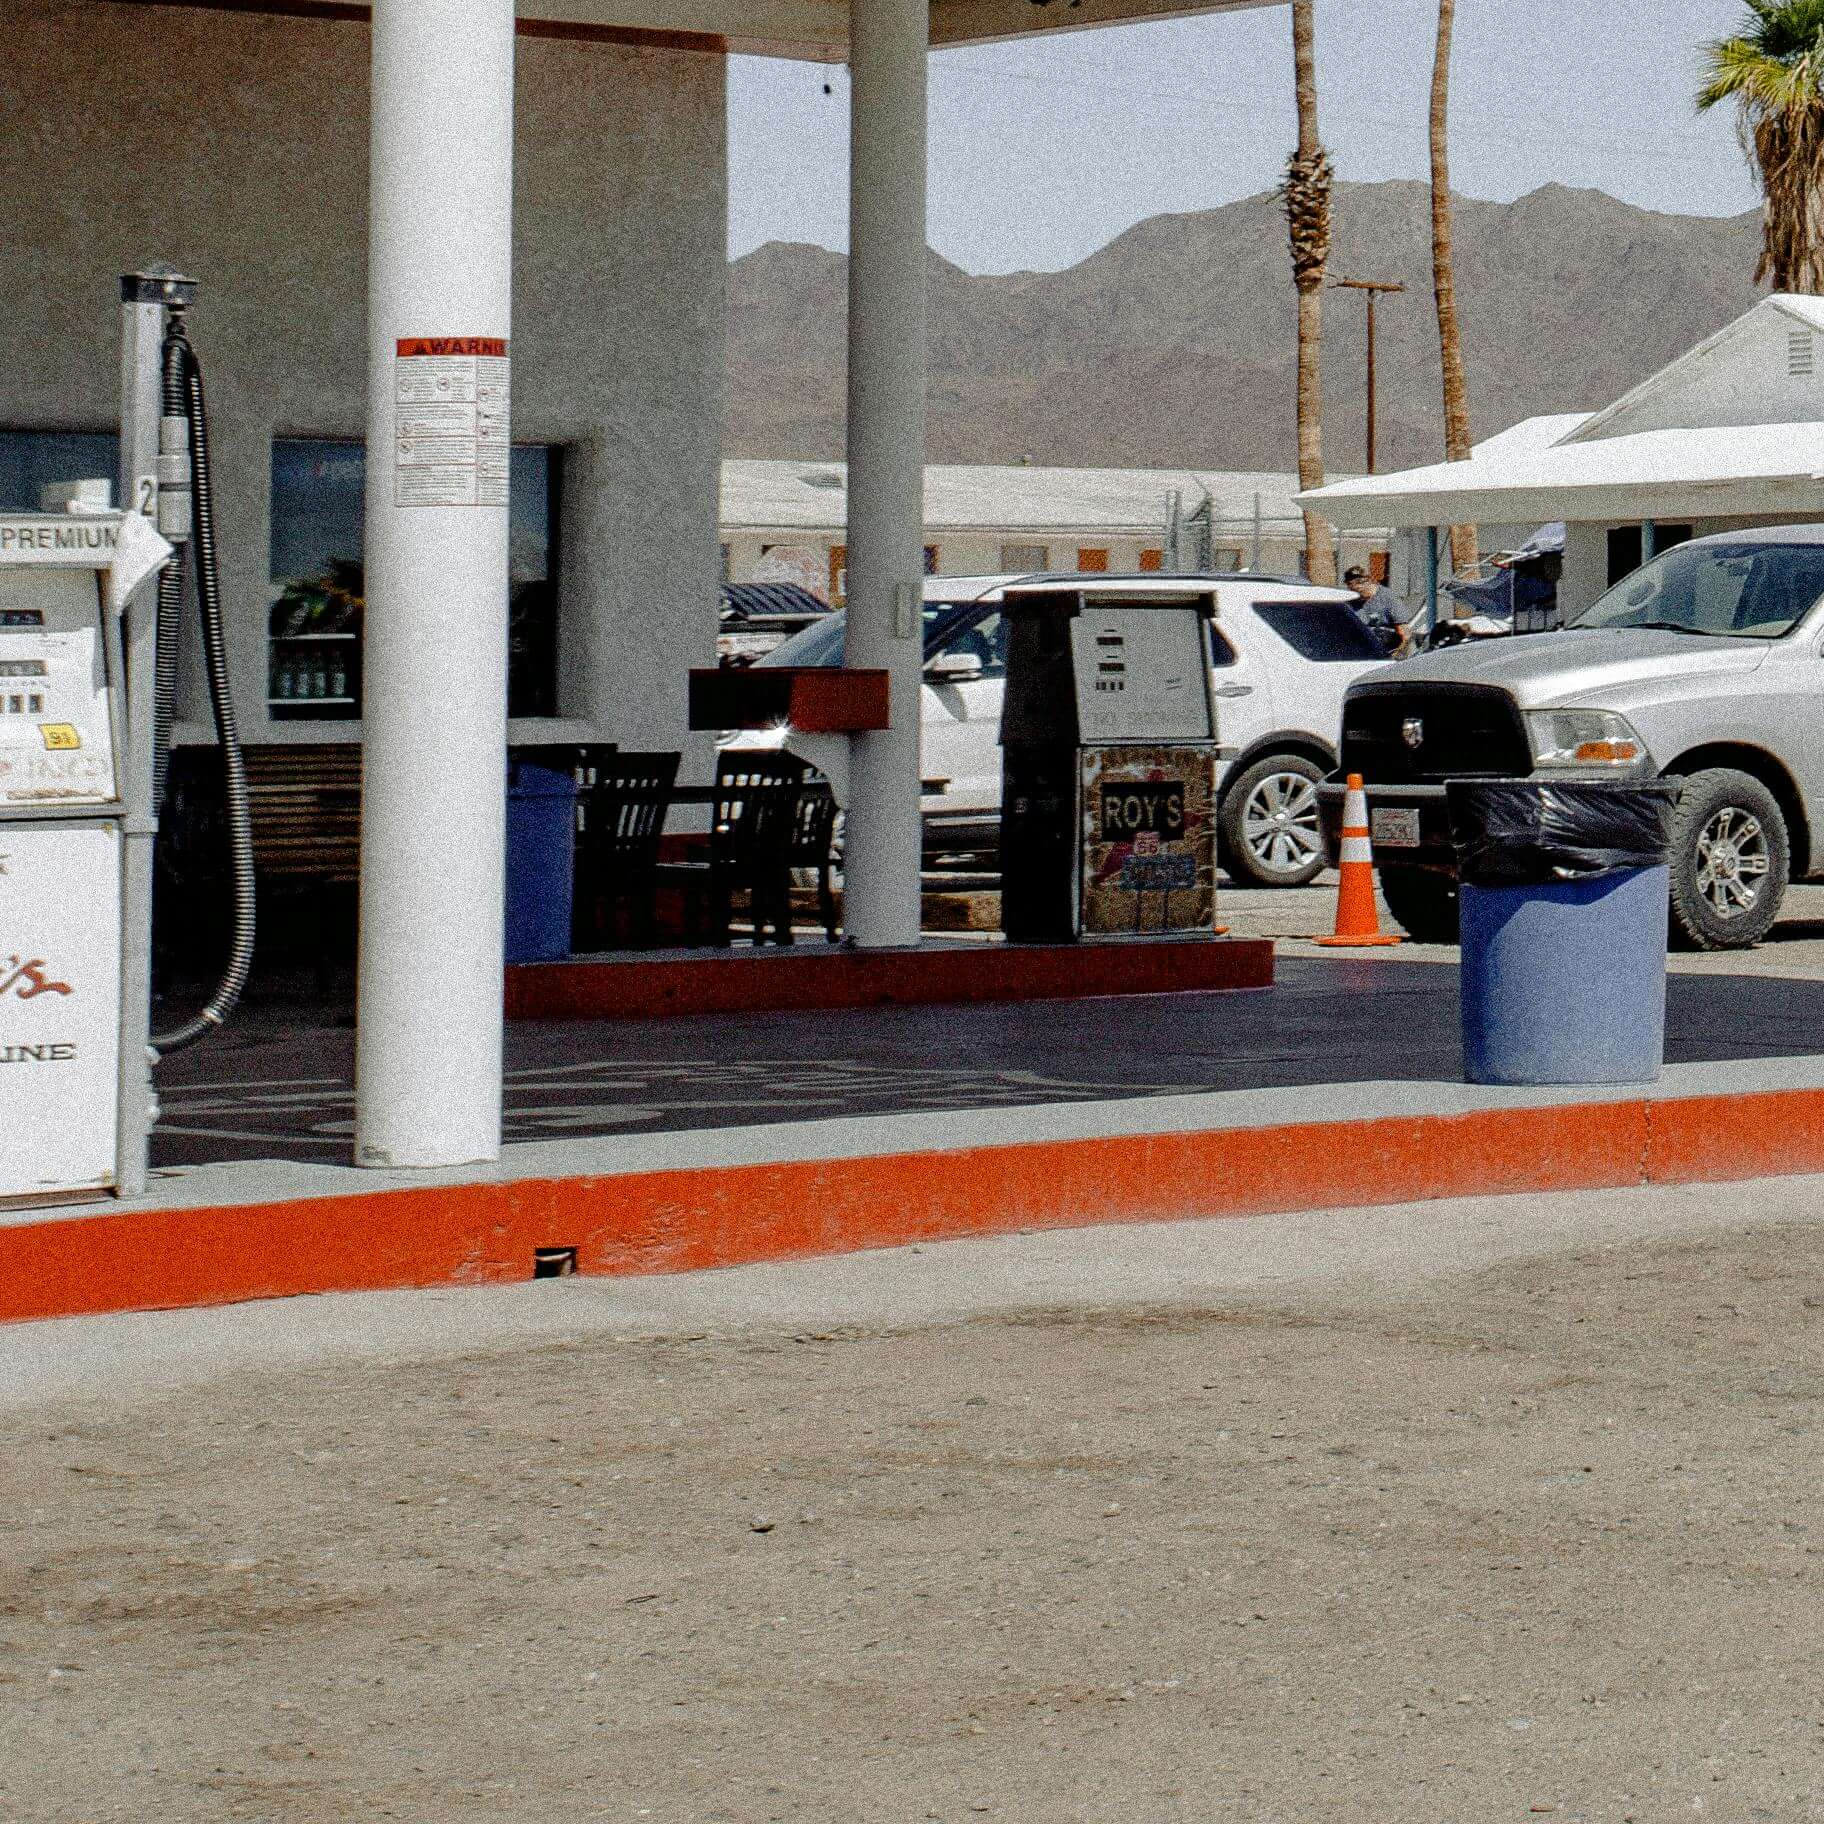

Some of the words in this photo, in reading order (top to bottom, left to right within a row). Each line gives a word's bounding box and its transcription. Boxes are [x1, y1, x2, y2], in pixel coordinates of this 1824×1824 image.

[139, 479, 153, 516] 2
[1, 527, 118, 549] PREMIUM
[1105, 794, 1182, 830] ROY'S
